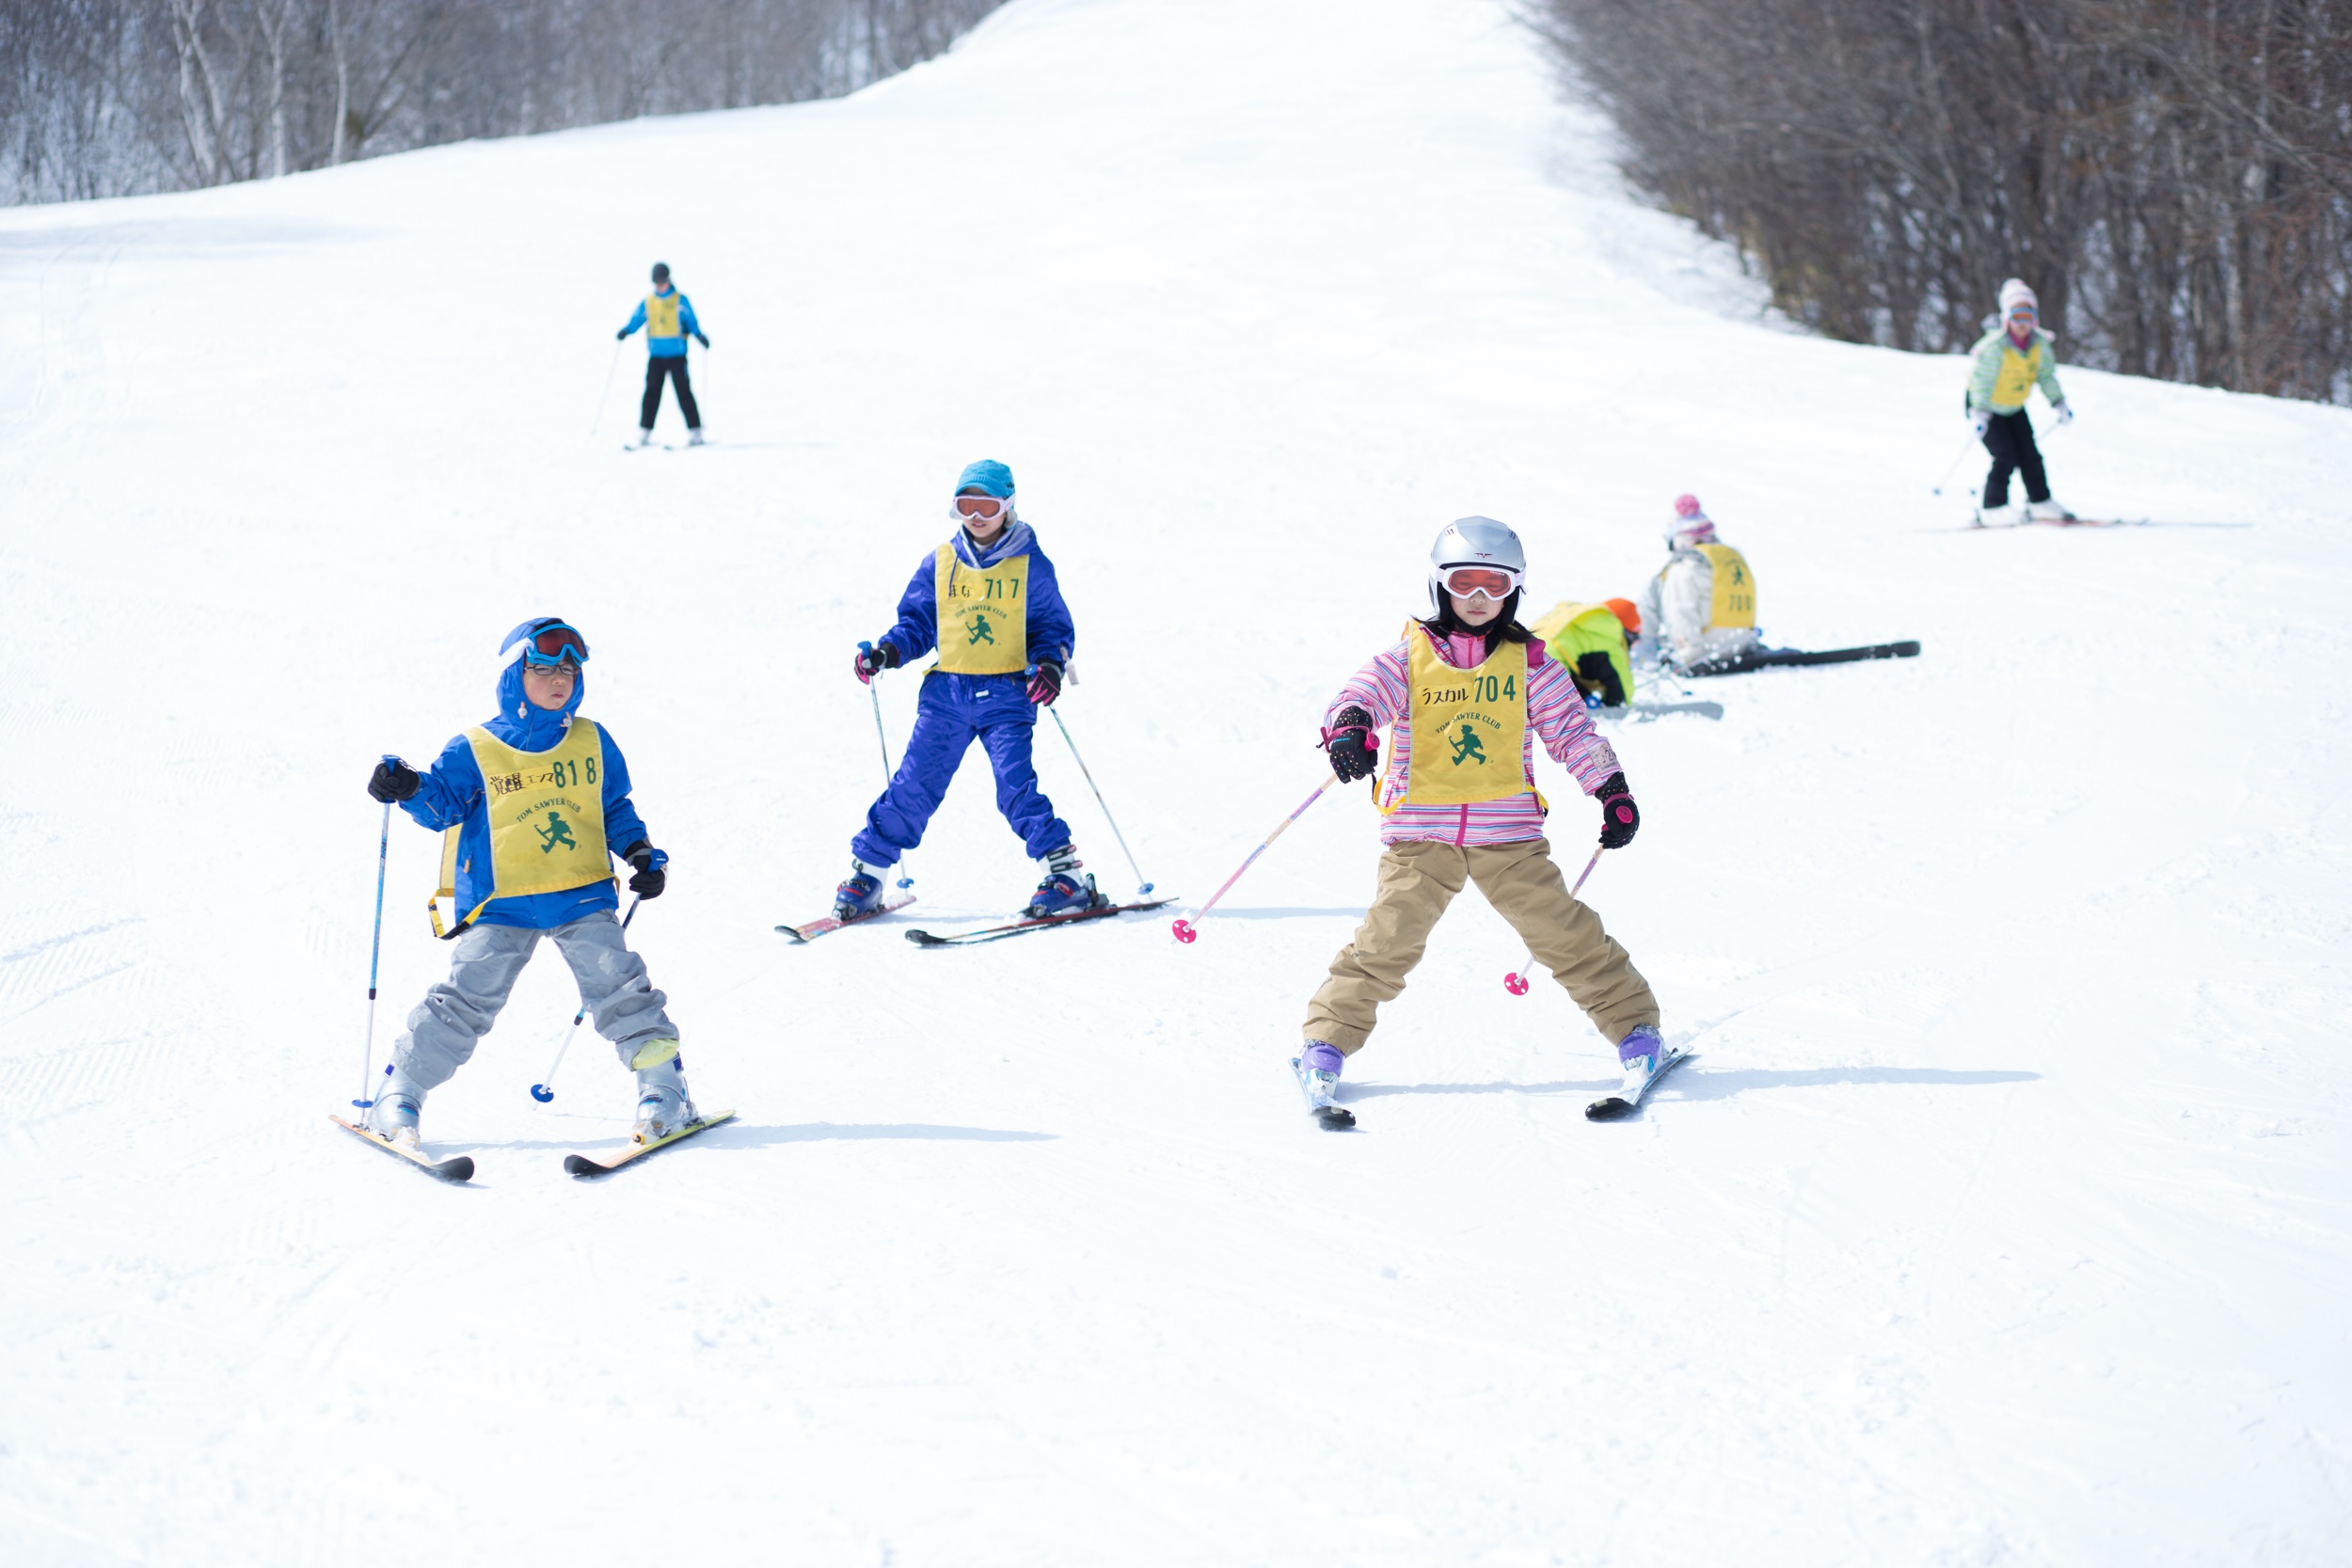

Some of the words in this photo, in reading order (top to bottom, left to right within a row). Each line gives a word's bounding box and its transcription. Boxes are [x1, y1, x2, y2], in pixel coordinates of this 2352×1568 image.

[985, 578, 1019, 599] 717
[954, 609, 967, 619] TOM
[993, 608, 1008, 620] CLUB
[1422, 688, 1470, 705] ラスカル
[1474, 674, 1517, 704] 704
[1435, 721, 1451, 735] TOM
[1452, 711, 1481, 723] SAWYER
[1482, 715, 1502, 730] CLUB
[552, 756, 597, 788] 818
[516, 807, 533, 823] TOM
[533, 798, 566, 810] SAWYER
[565, 799, 582, 814] CLUB
